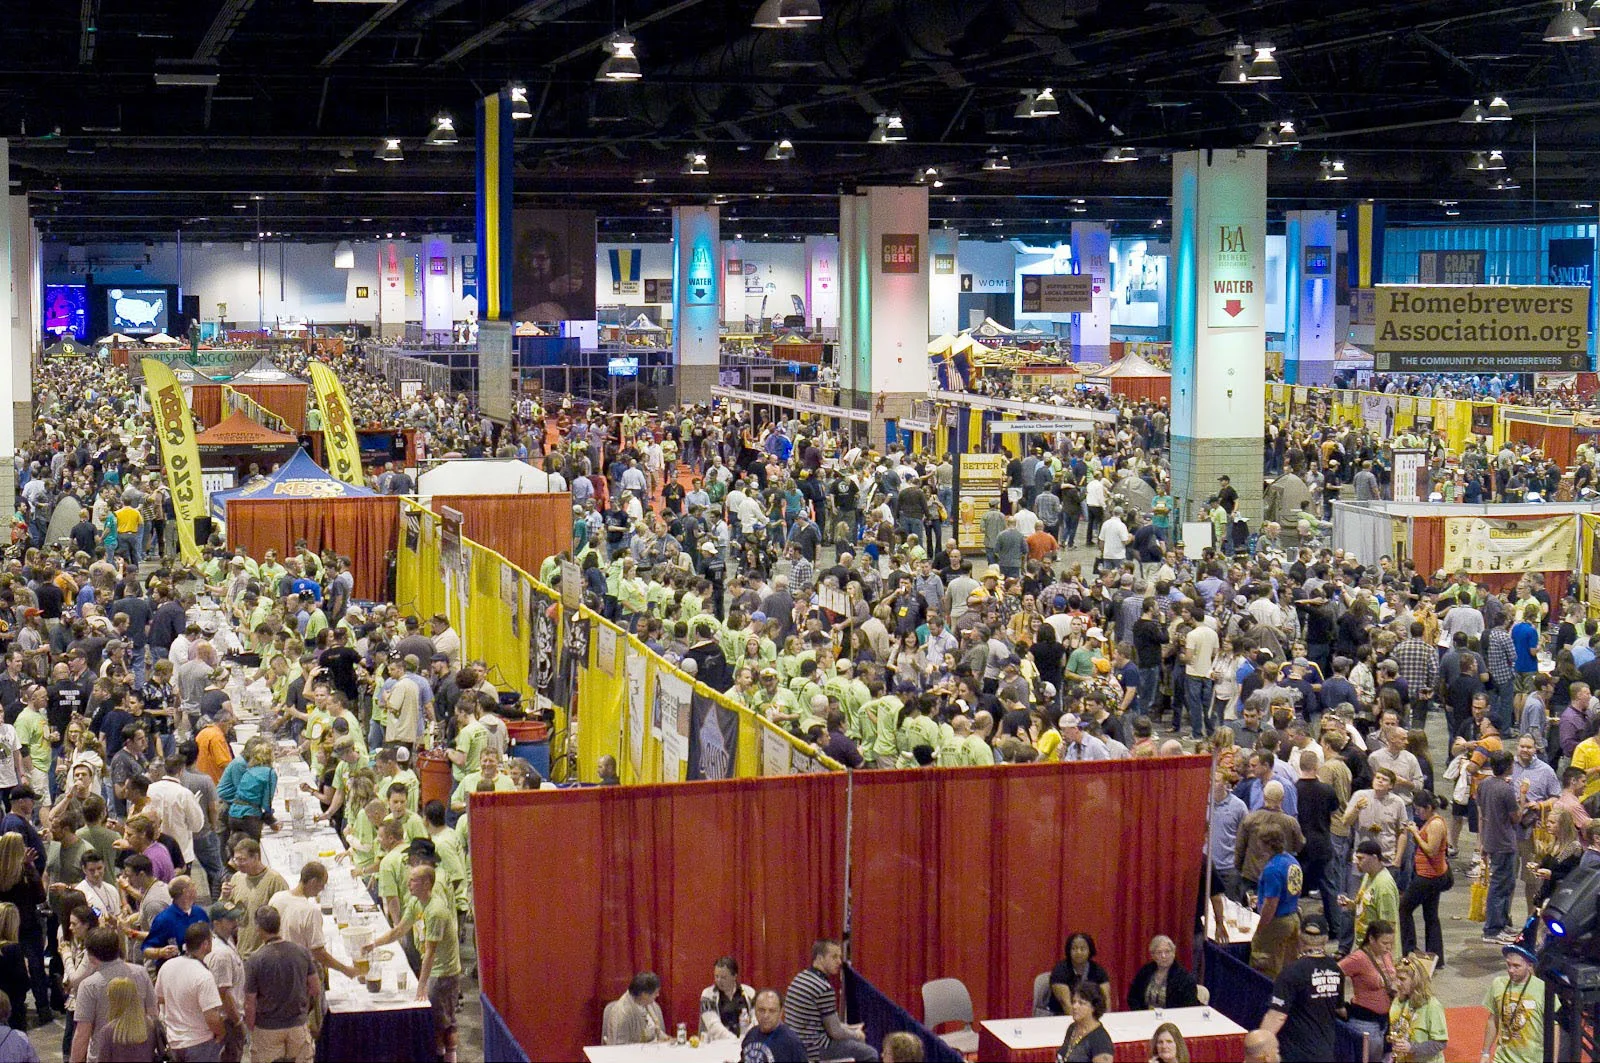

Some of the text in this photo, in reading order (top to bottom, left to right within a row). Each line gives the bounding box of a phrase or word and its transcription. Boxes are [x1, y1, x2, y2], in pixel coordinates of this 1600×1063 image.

[884, 245, 916, 254] CRAFT
[884, 254, 913, 262] BEER
[1444, 254, 1480, 272] CRAFT
[1550, 264, 1591, 284] SAMUEL
[689, 278, 712, 286] WATER
[1214, 280, 1254, 293] WATER
[1389, 292, 1573, 314] Homebrewers
[1379, 319, 1582, 349] Association.org
[1401, 357, 1562, 365] THE COMMUNITY FOR HOMEBREWERS
